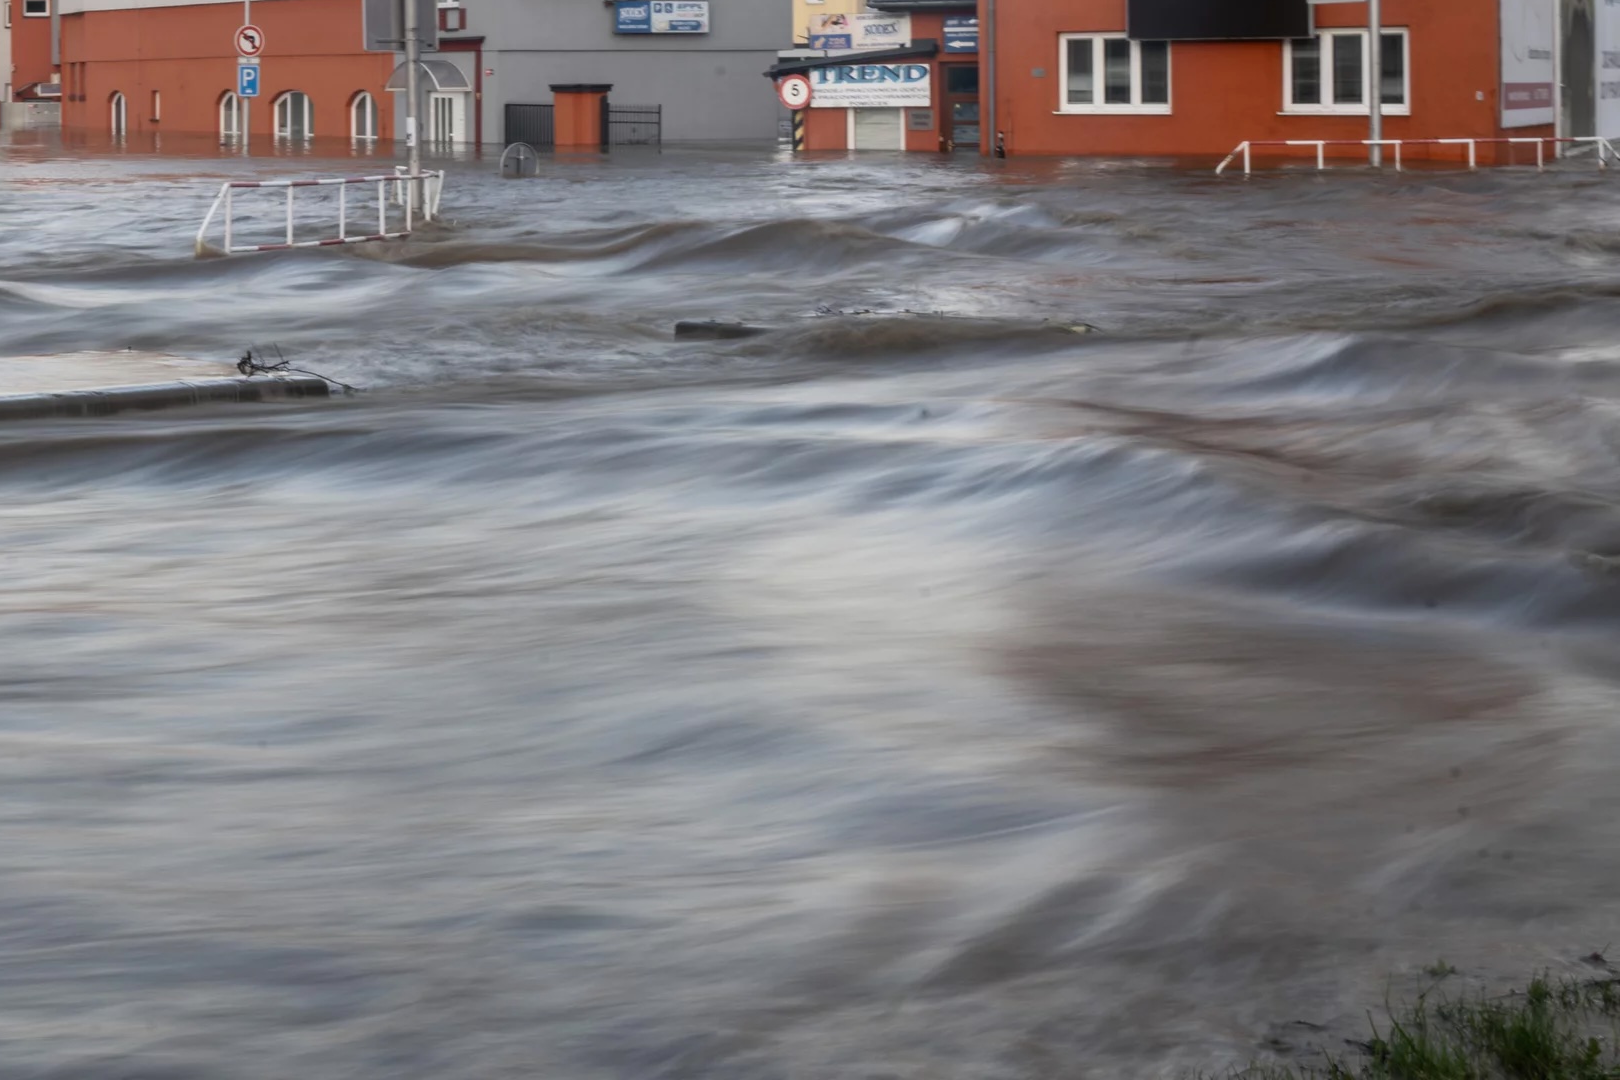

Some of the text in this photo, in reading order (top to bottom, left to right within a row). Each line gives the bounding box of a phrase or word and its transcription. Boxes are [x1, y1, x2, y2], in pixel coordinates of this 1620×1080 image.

[243, 69, 255, 87] P
[811, 65, 929, 84] TREND
[791, 84, 800, 96] 5
